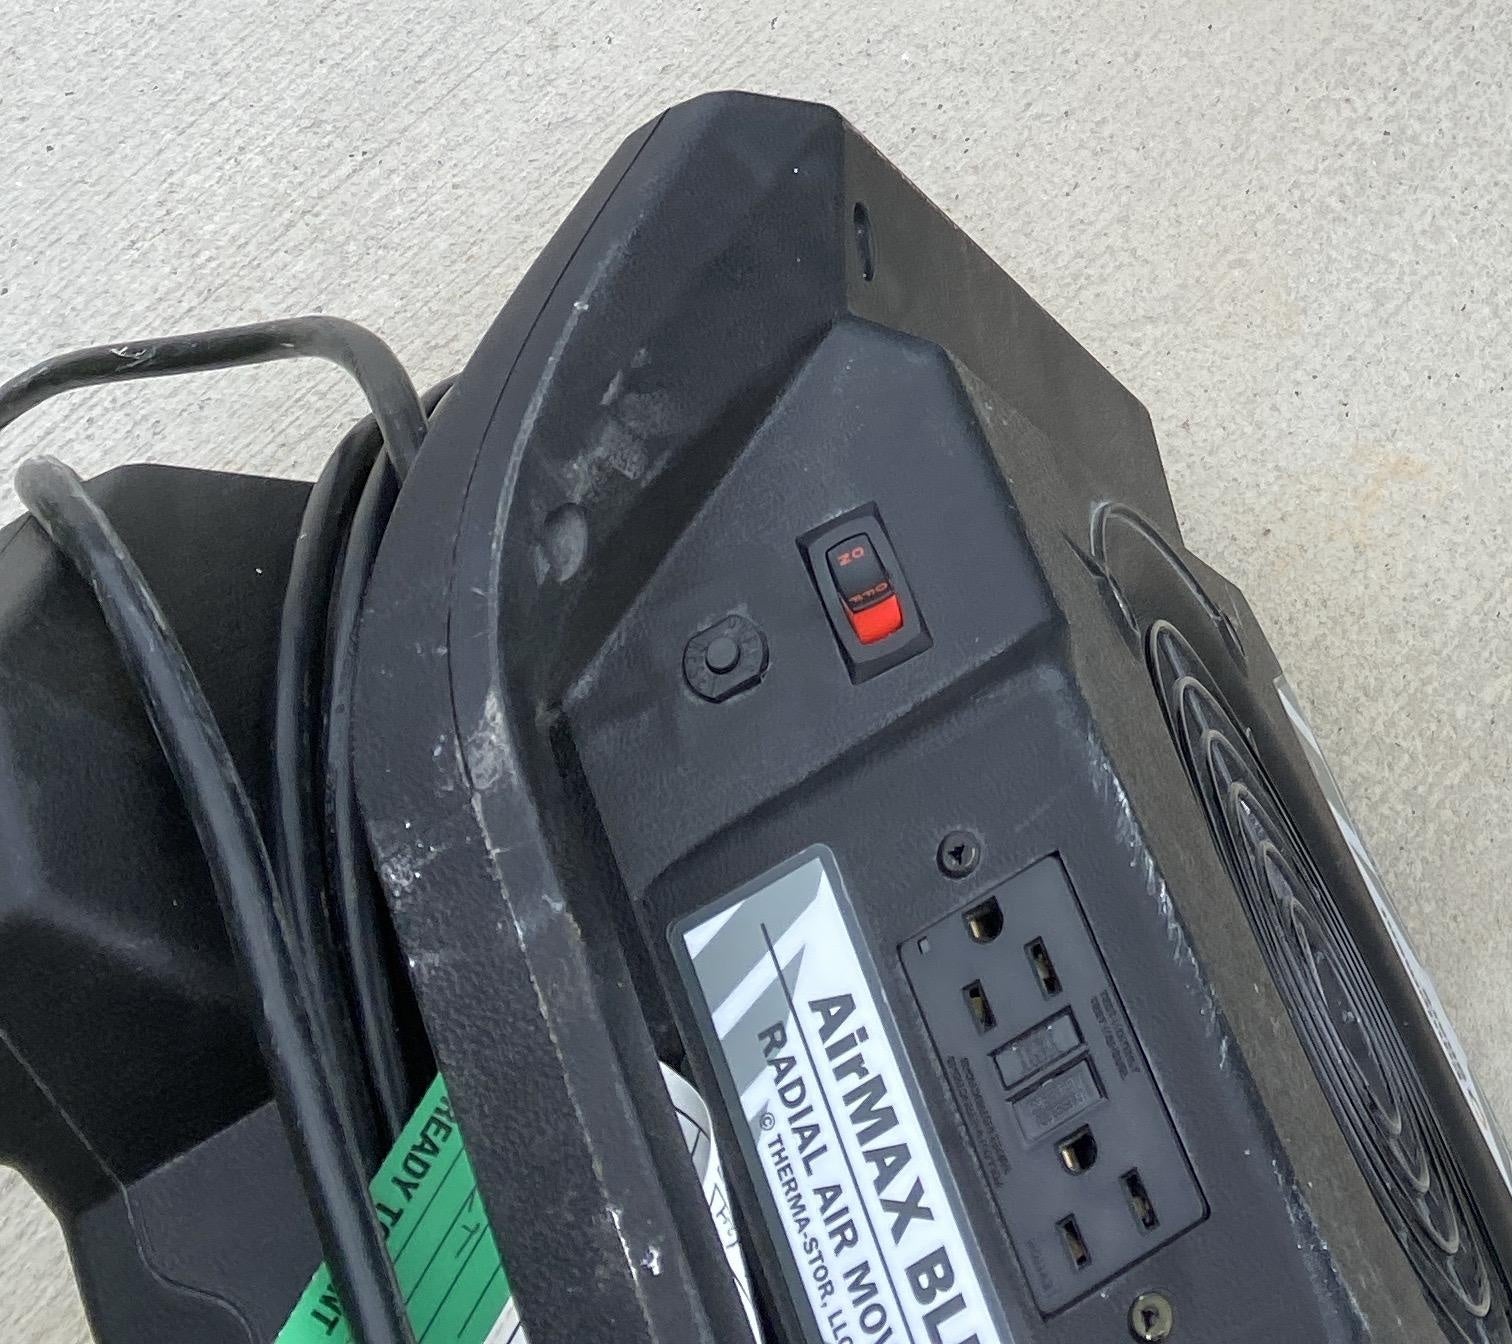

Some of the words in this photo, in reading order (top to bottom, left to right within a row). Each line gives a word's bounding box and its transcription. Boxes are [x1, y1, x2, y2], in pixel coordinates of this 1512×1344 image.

[757, 1020, 828, 1178] RADIAL
[812, 1184, 860, 1258] AIR
[807, 993, 936, 1247] AirMAX
[904, 1245, 983, 1344] BL
